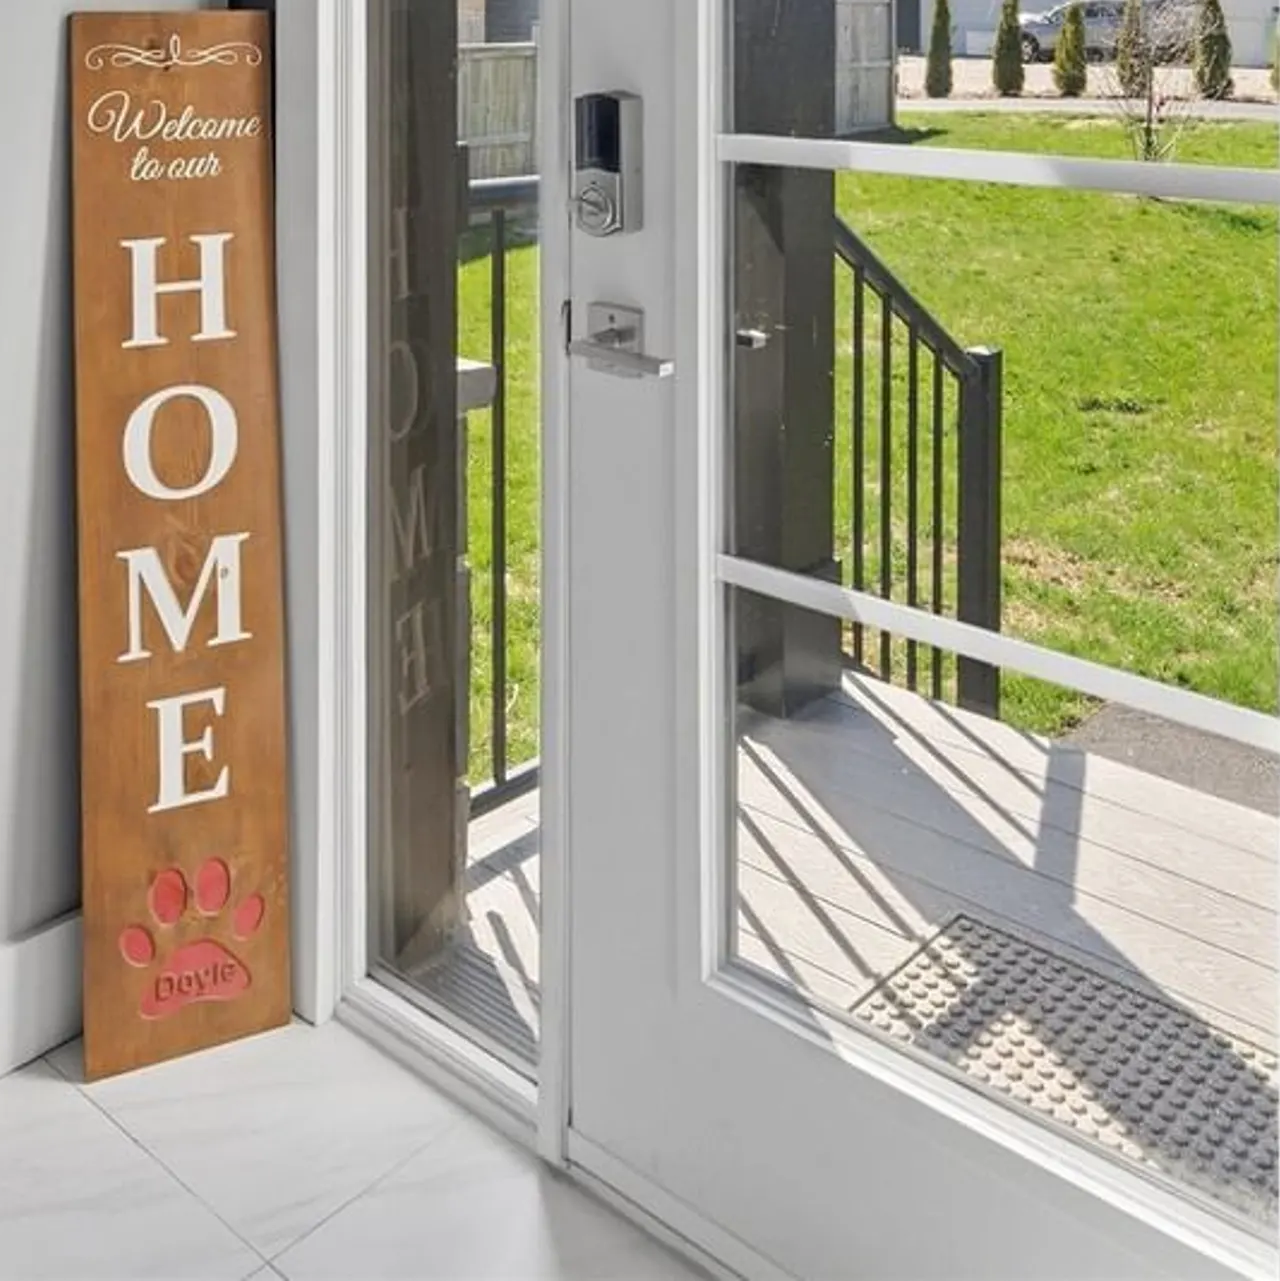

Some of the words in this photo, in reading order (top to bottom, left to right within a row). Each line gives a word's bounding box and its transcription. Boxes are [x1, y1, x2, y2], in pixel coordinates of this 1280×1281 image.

[88, 90, 262, 142] Welcome
[131, 146, 163, 181] to
[168, 152, 222, 180] our
[116, 232, 253, 813] HOME
